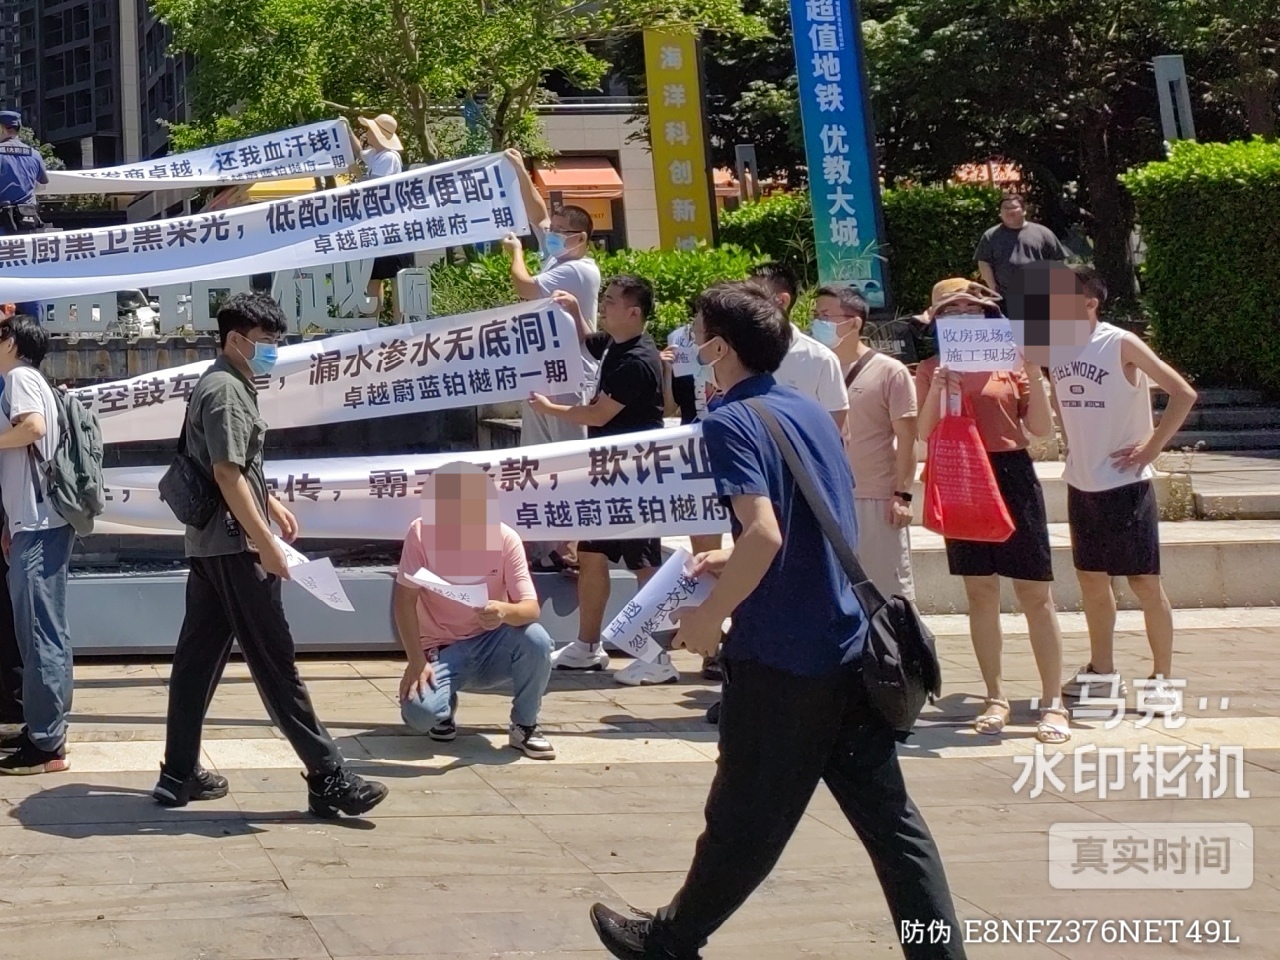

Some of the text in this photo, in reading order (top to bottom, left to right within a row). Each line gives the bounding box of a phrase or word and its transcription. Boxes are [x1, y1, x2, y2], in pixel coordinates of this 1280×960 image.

[820, 125, 860, 247] 优教大城
[314, 206, 515, 255] 卓越蔚蓝铂樾府一期
[945, 348, 1016, 362] 施工现场
[343, 359, 569, 409] 卓越蔚蓝铂樾府一期
[516, 493, 727, 529] 卓越蔚蓝铂樾府
